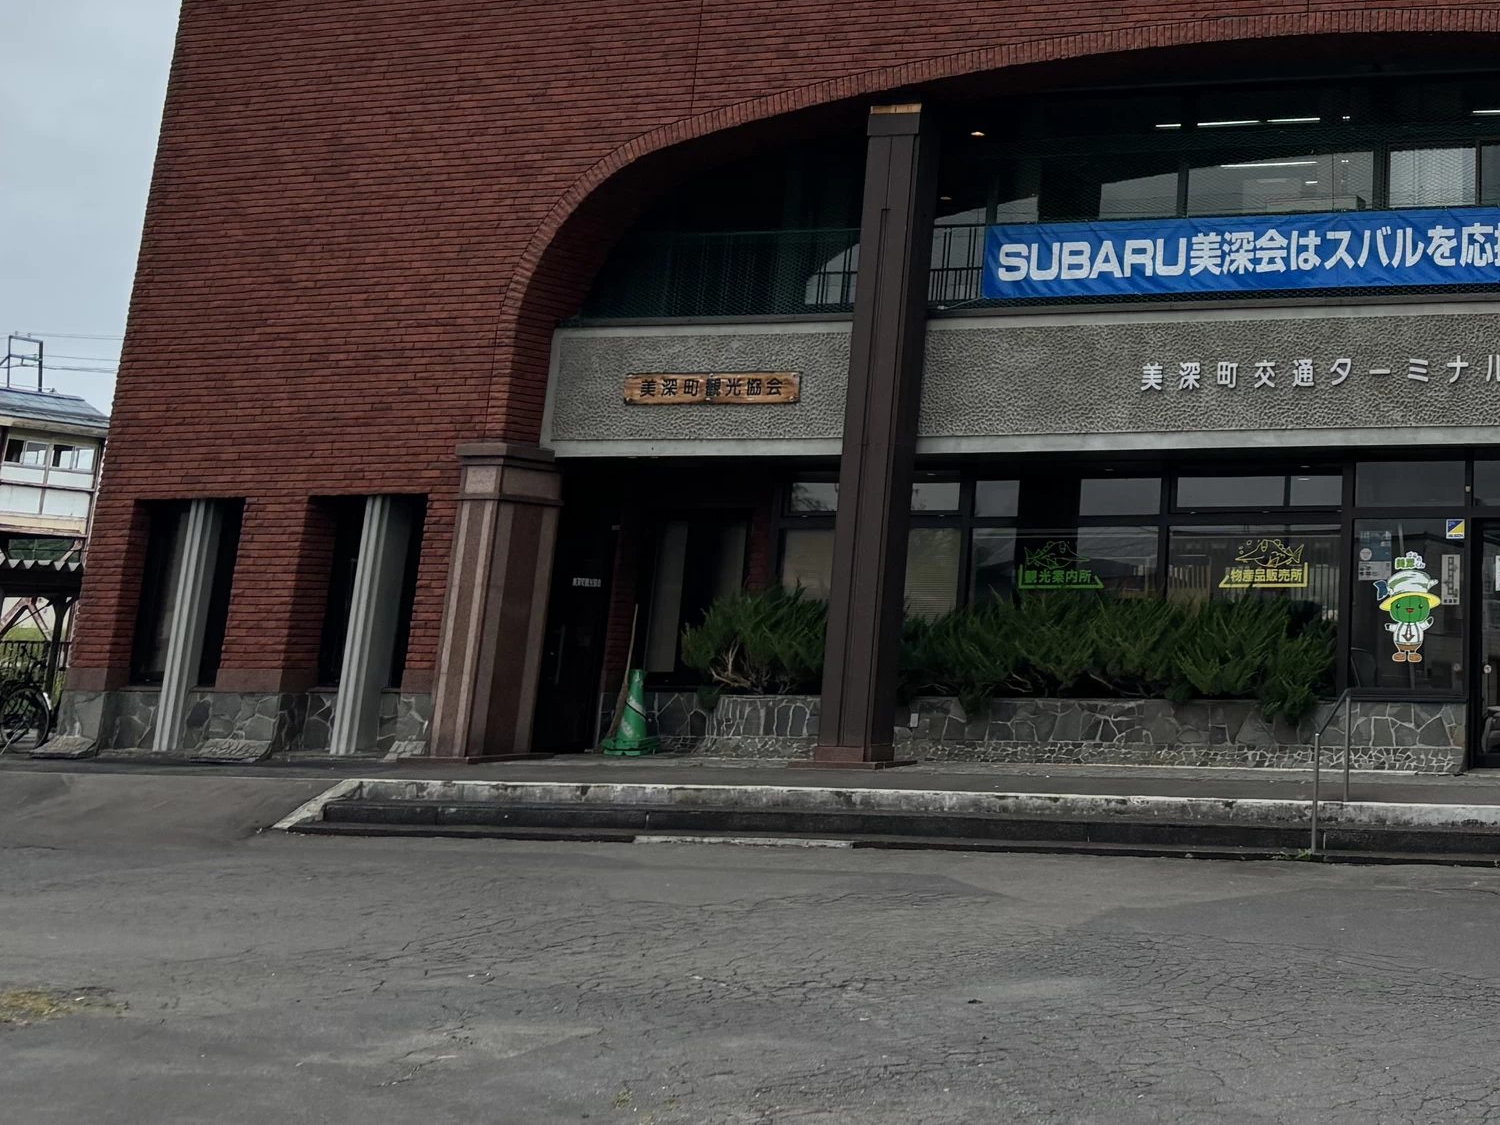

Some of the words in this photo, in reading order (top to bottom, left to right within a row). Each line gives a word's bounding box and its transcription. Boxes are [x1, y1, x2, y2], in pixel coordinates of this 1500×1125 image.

[640, 377, 783, 398] 美深町観光協会
[1025, 569, 1092, 584] 観光案内所
[1231, 568, 1303, 583] 物産品販売所
